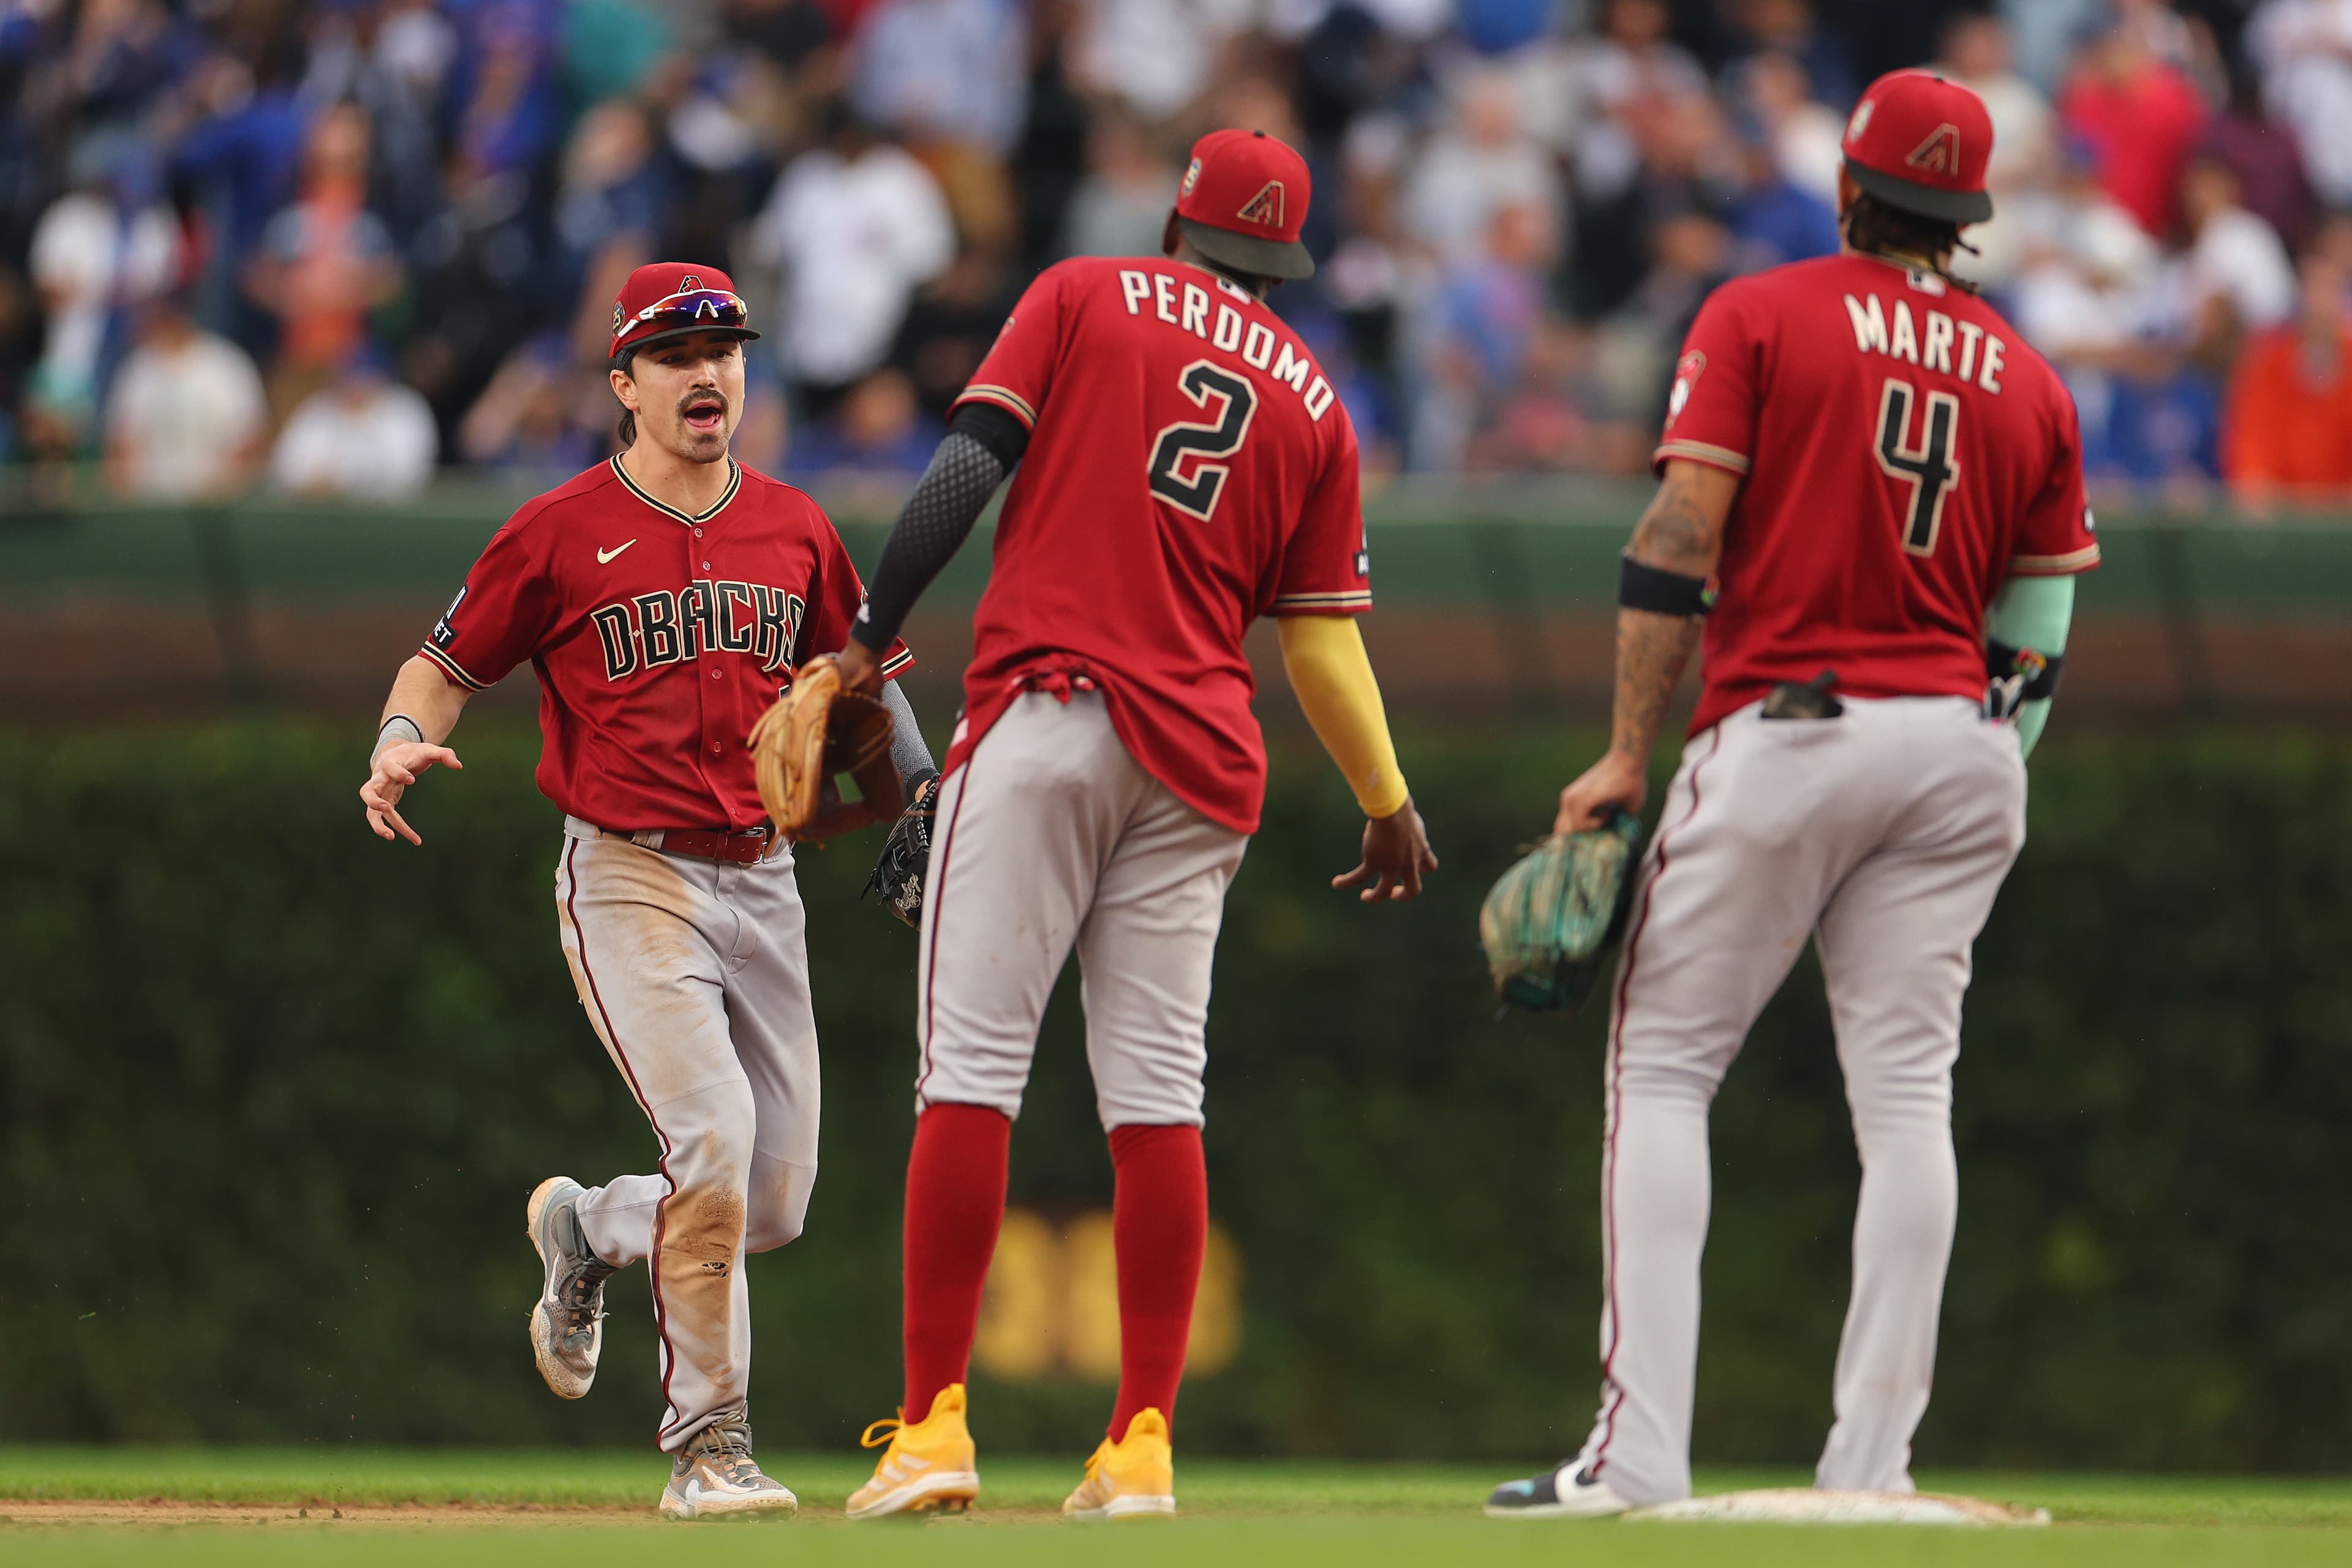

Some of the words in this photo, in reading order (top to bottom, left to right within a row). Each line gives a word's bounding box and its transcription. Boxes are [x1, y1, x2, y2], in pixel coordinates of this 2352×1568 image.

[1119, 270, 1335, 422] PERDOMO
[1843, 292, 2006, 395] MARTE
[1147, 358, 1259, 523] 2
[1872, 377, 1961, 558] 4
